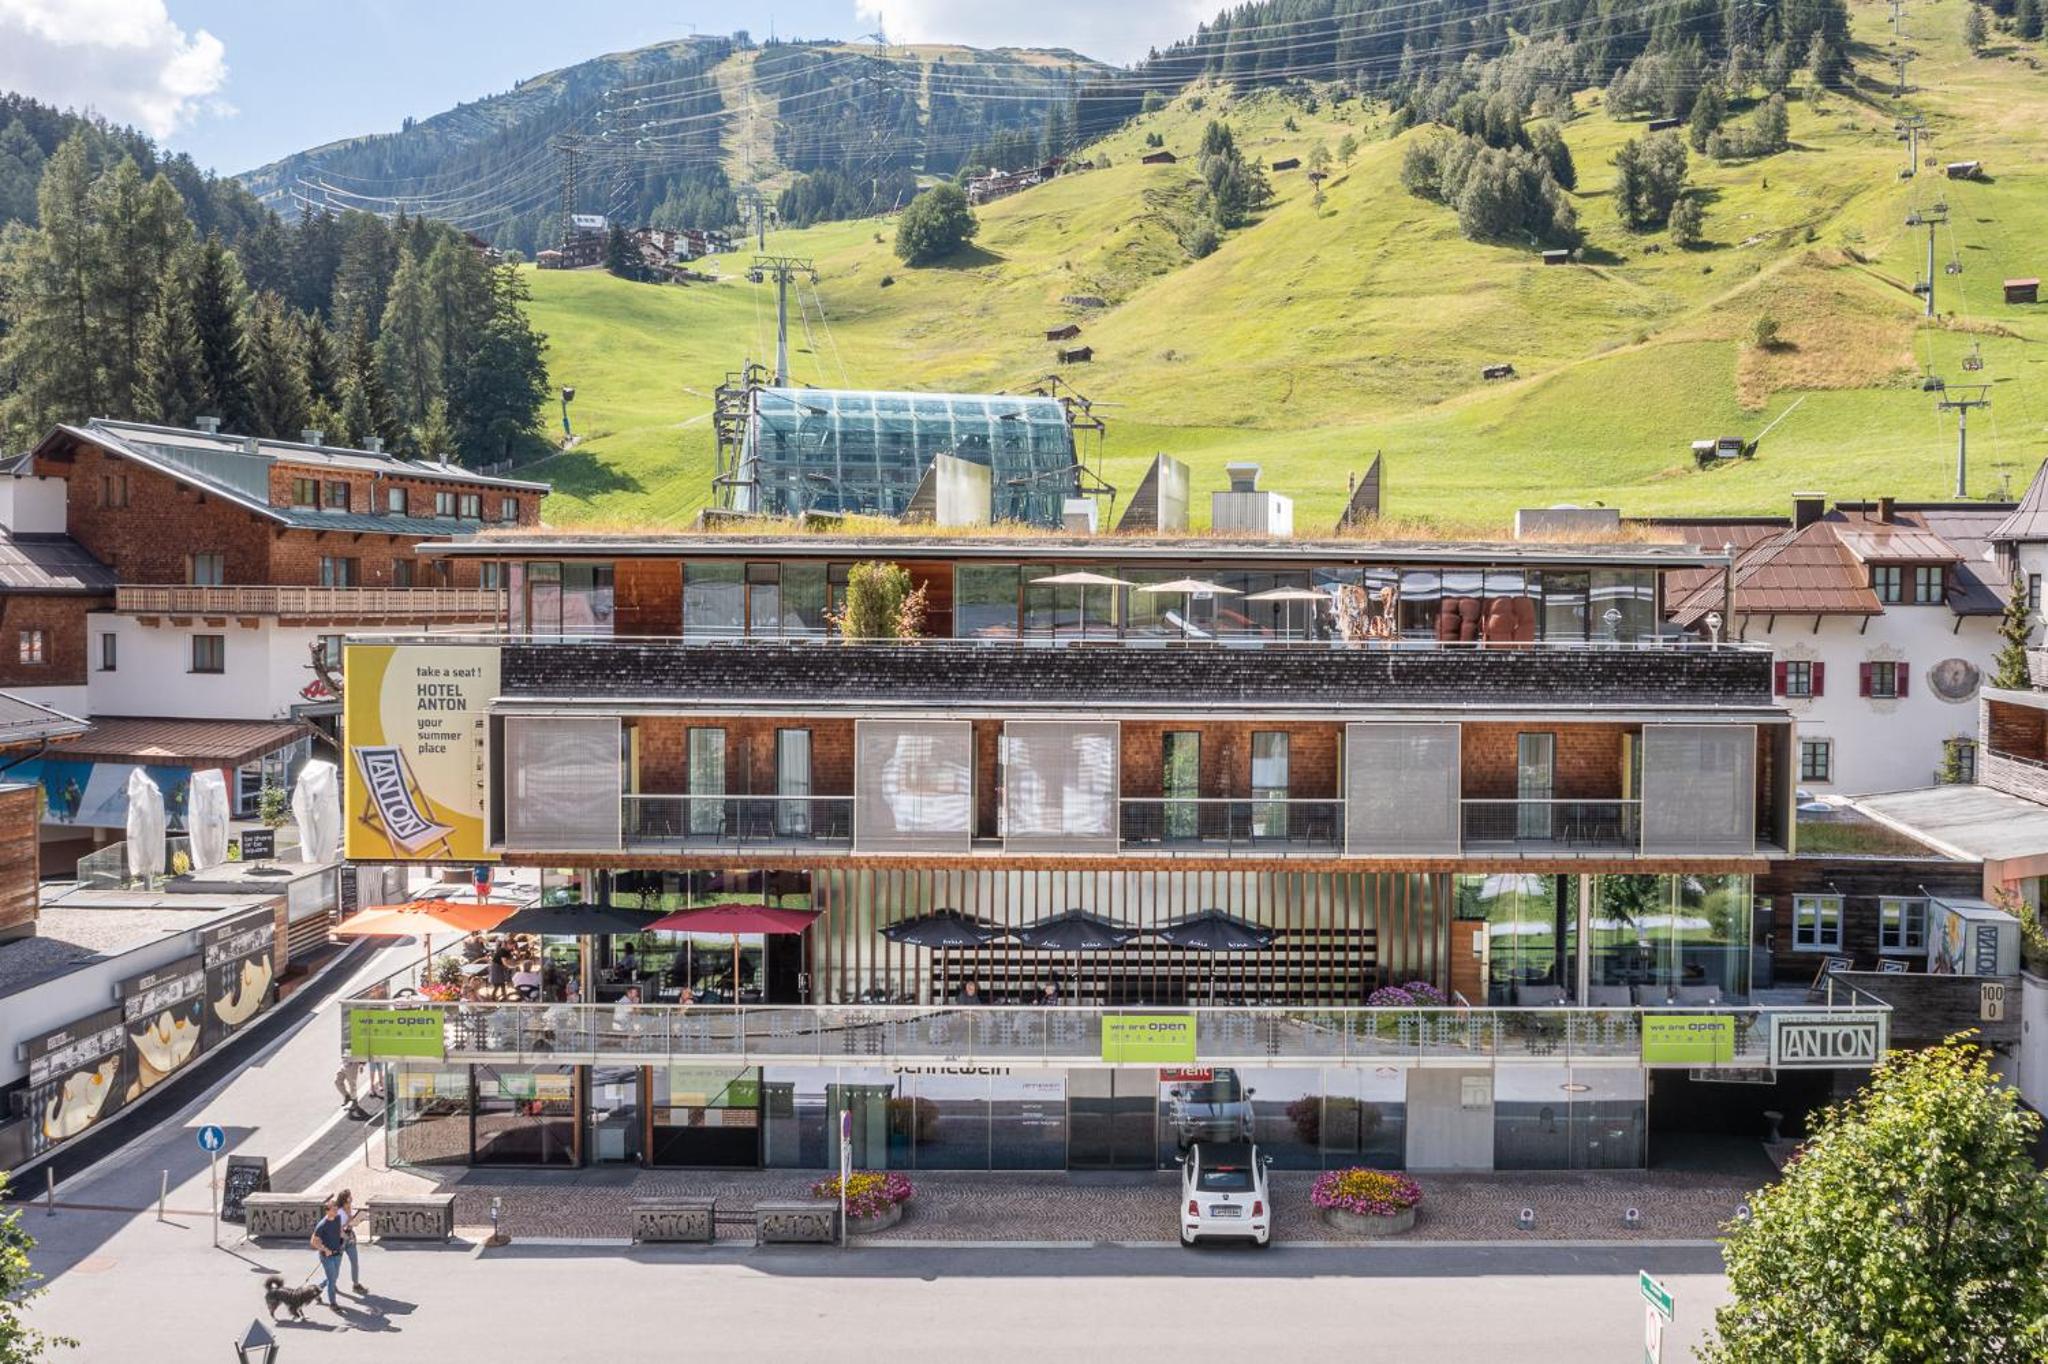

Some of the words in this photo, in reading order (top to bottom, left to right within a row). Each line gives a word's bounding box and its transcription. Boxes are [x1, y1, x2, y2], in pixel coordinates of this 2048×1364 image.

[417, 666, 441, 677] take
[443, 669, 450, 677] a
[417, 684, 463, 697] HOTEL
[417, 698, 467, 711] ANTON
[417, 719, 443, 730] your
[418, 732, 462, 741] summer
[418, 742, 447, 755] place
[371, 759, 423, 836] ANTON
[1983, 986, 2003, 1001] 100
[1988, 1002, 1996, 1018] 0
[397, 1017, 436, 1027] open
[1110, 1023, 1125, 1031] we
[1148, 1022, 1187, 1032] open
[1650, 1023, 1664, 1031] we
[1688, 1023, 1725, 1032] open
[1784, 1027, 1876, 1058] ANTON
